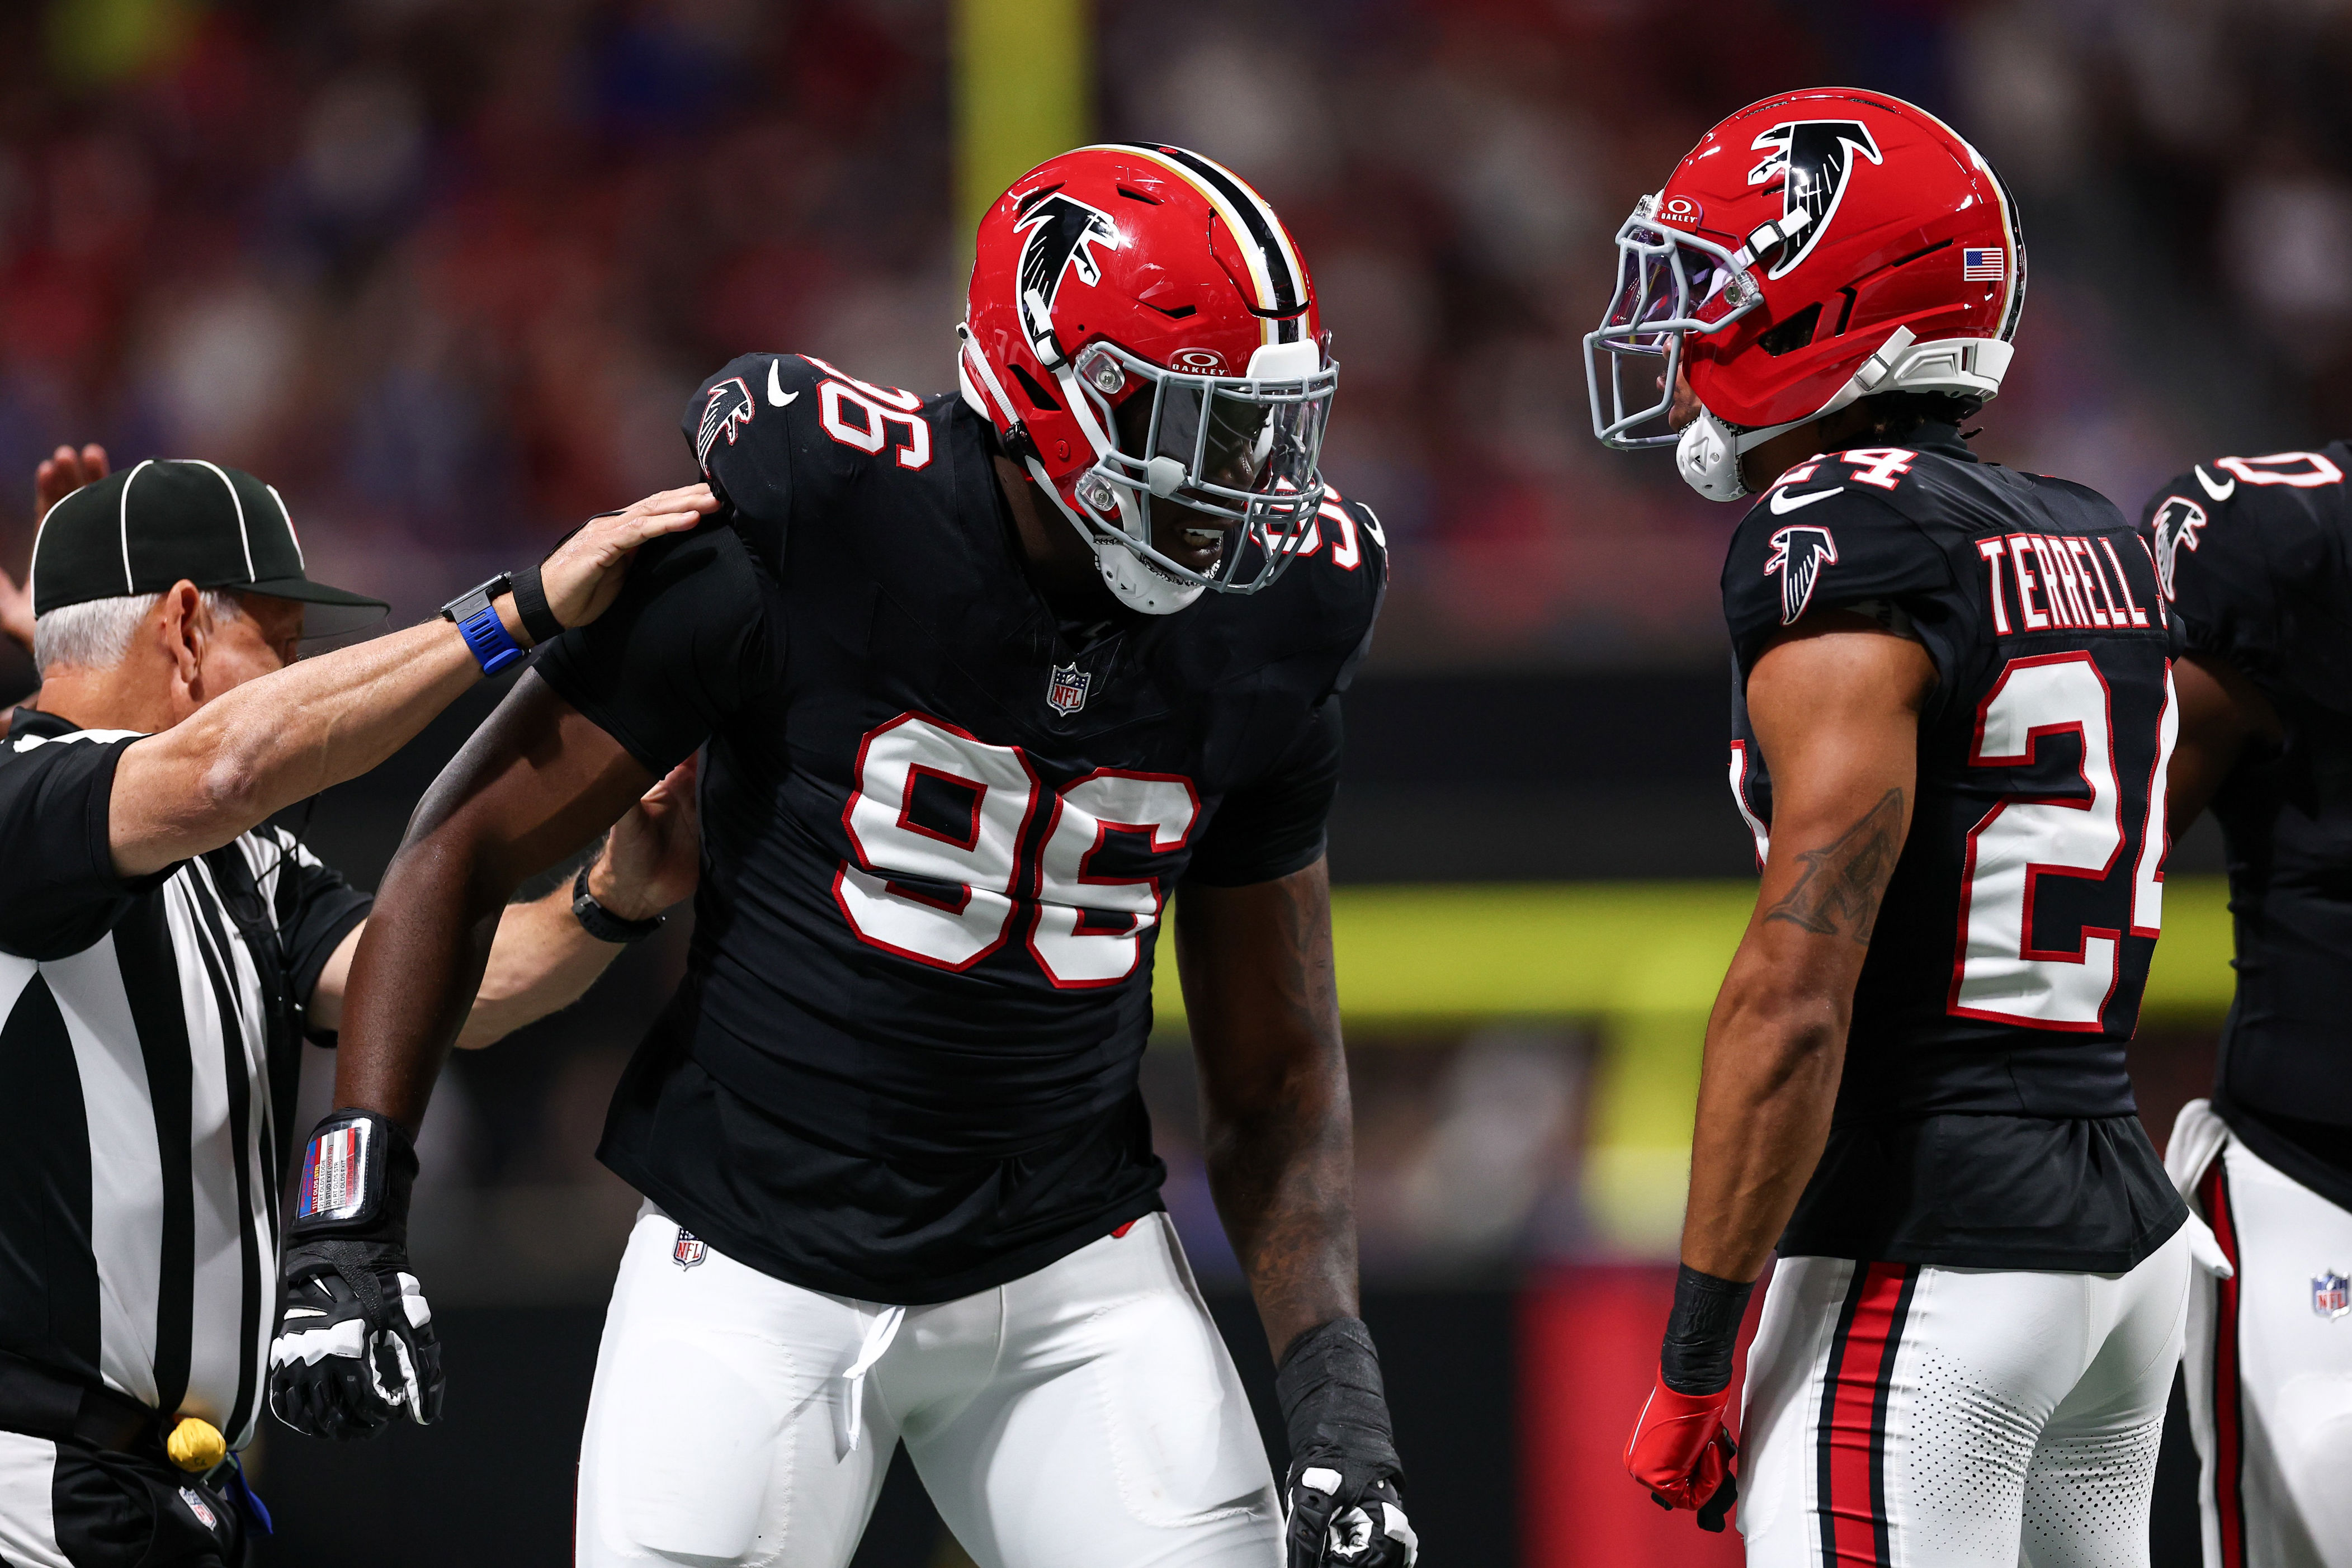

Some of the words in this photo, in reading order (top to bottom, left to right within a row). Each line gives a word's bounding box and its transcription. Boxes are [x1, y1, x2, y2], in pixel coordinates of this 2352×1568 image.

[1661, 213, 1697, 223] OAKLEY
[1172, 363, 1226, 376] OAKLEY
[1975, 533, 2150, 636] TERRELL
[1053, 684, 1080, 707] NFL
[832, 710, 1201, 989] 96
[676, 1241, 700, 1260] NFL
